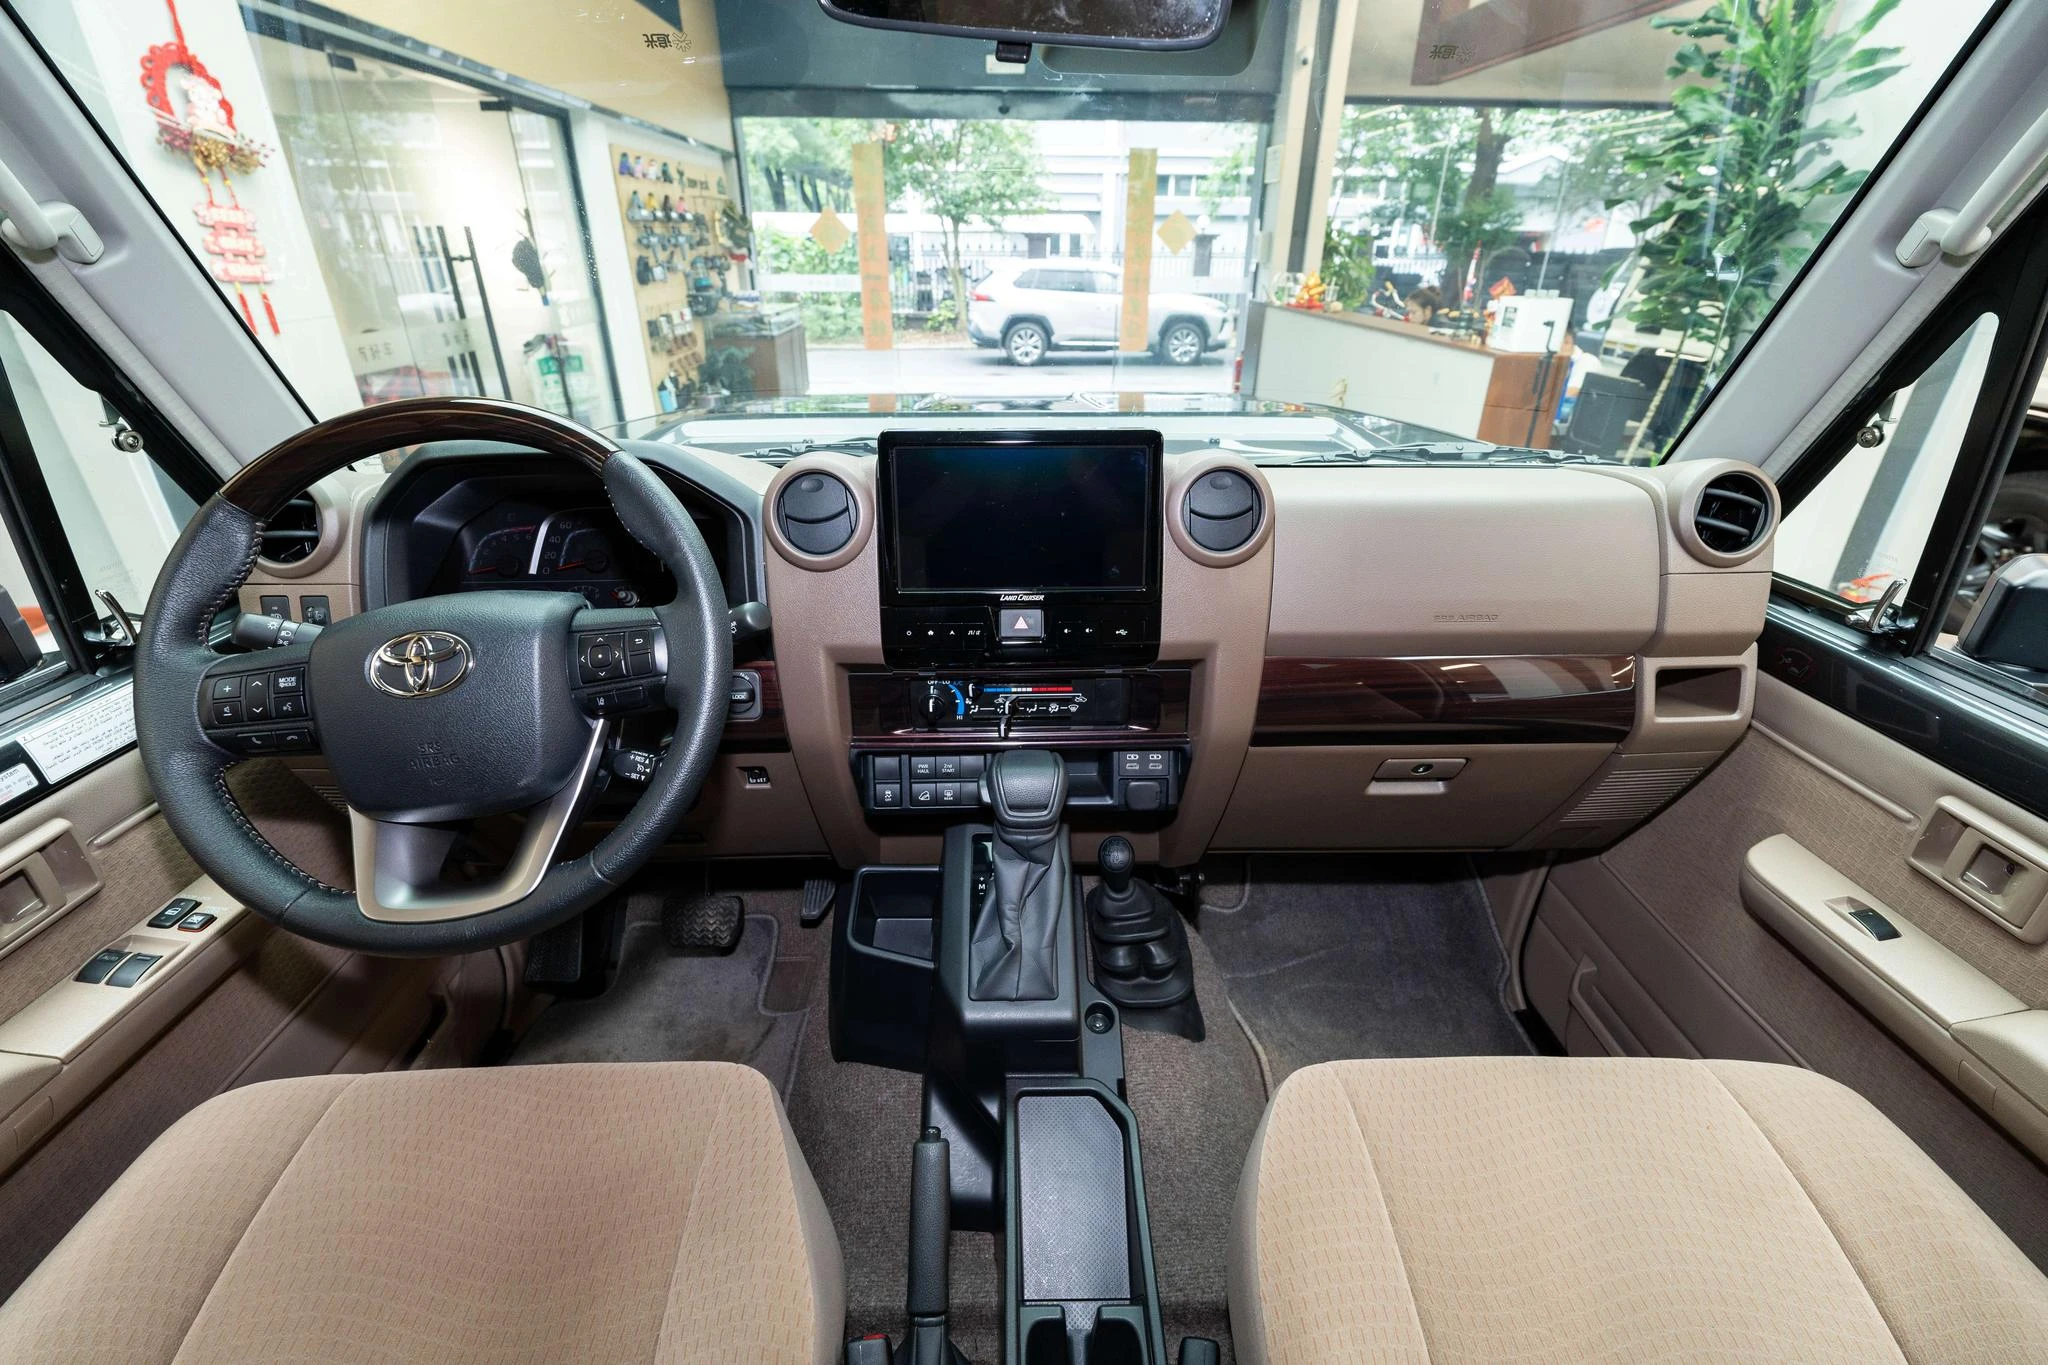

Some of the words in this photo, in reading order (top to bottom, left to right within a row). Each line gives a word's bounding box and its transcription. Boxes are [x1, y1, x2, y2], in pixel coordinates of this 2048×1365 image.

[560, 521, 571, 529] 60
[418, 742, 441, 753] SRS
[410, 754, 459, 770] AIRBAG
